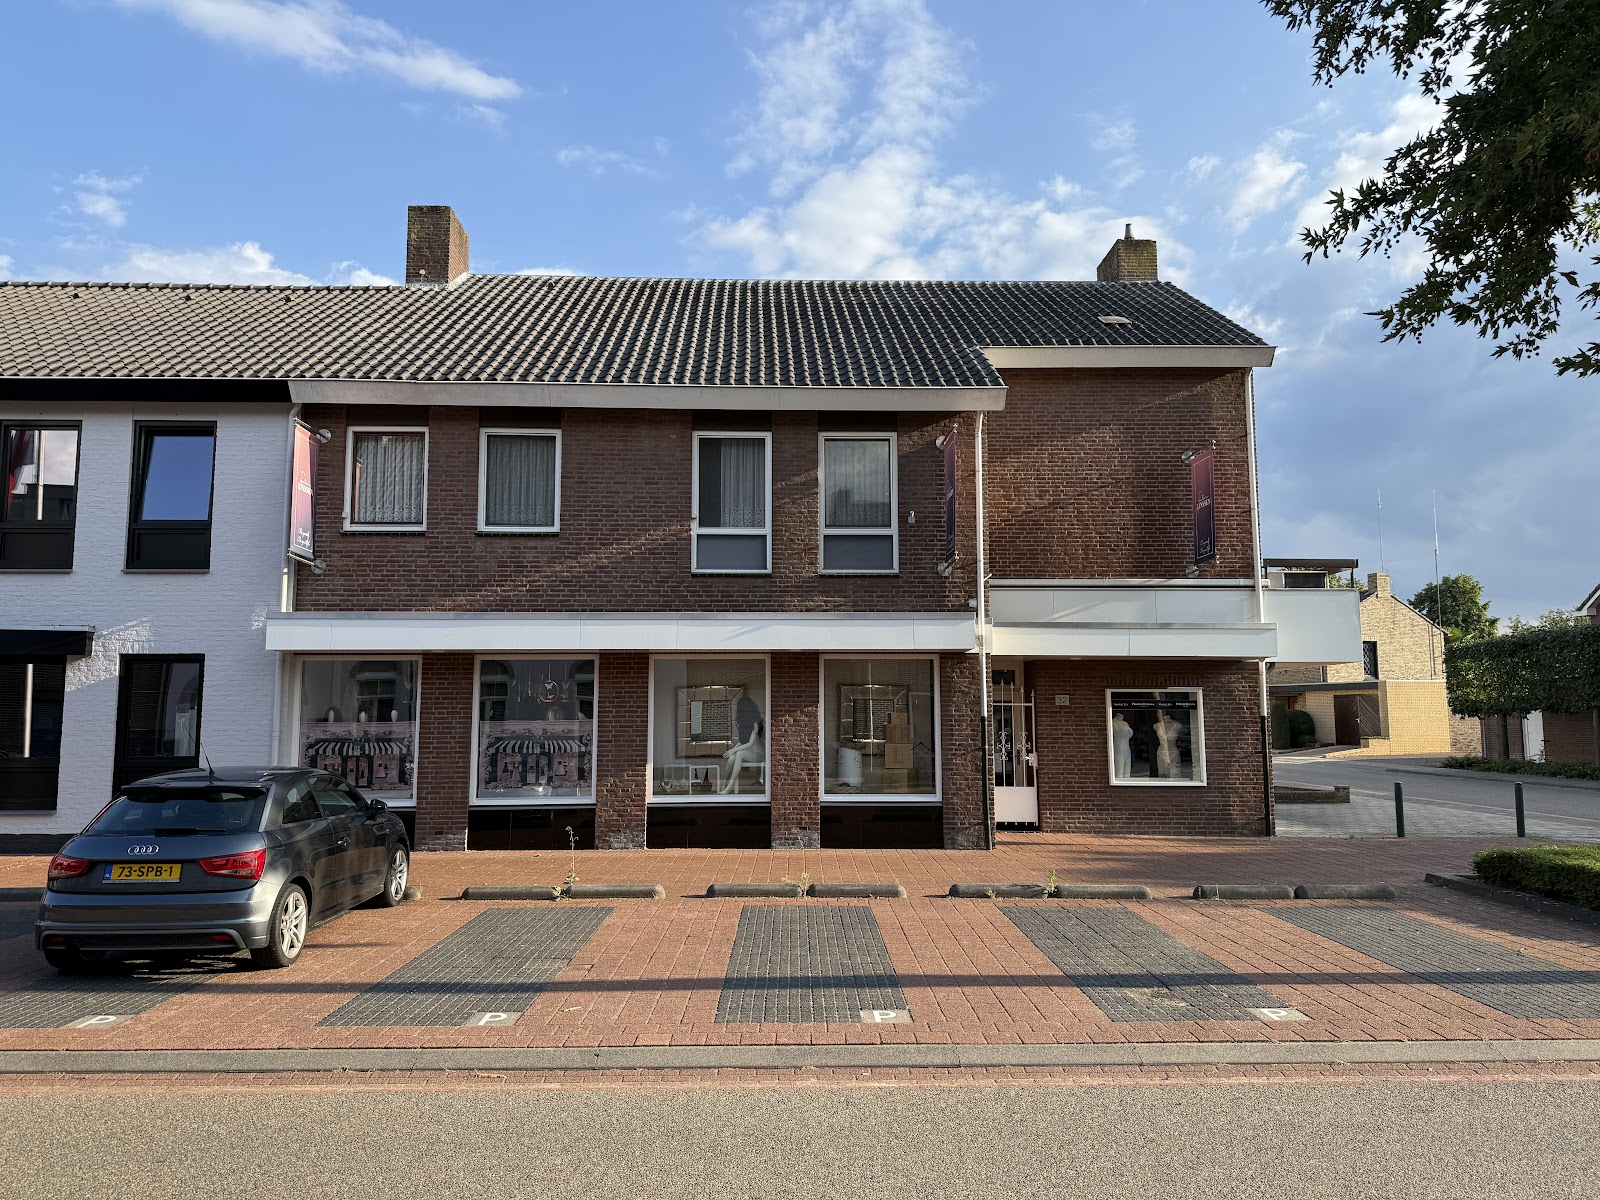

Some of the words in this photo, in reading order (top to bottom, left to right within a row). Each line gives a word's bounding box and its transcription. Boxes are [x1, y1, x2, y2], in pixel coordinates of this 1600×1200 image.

[1056, 696, 1068, 704] 32
[117, 865, 175, 878] 73-SPB-1
[477, 1012, 508, 1025] P
[872, 1010, 897, 1023] P
[1258, 1008, 1289, 1021] P
[75, 1015, 117, 1028] P
